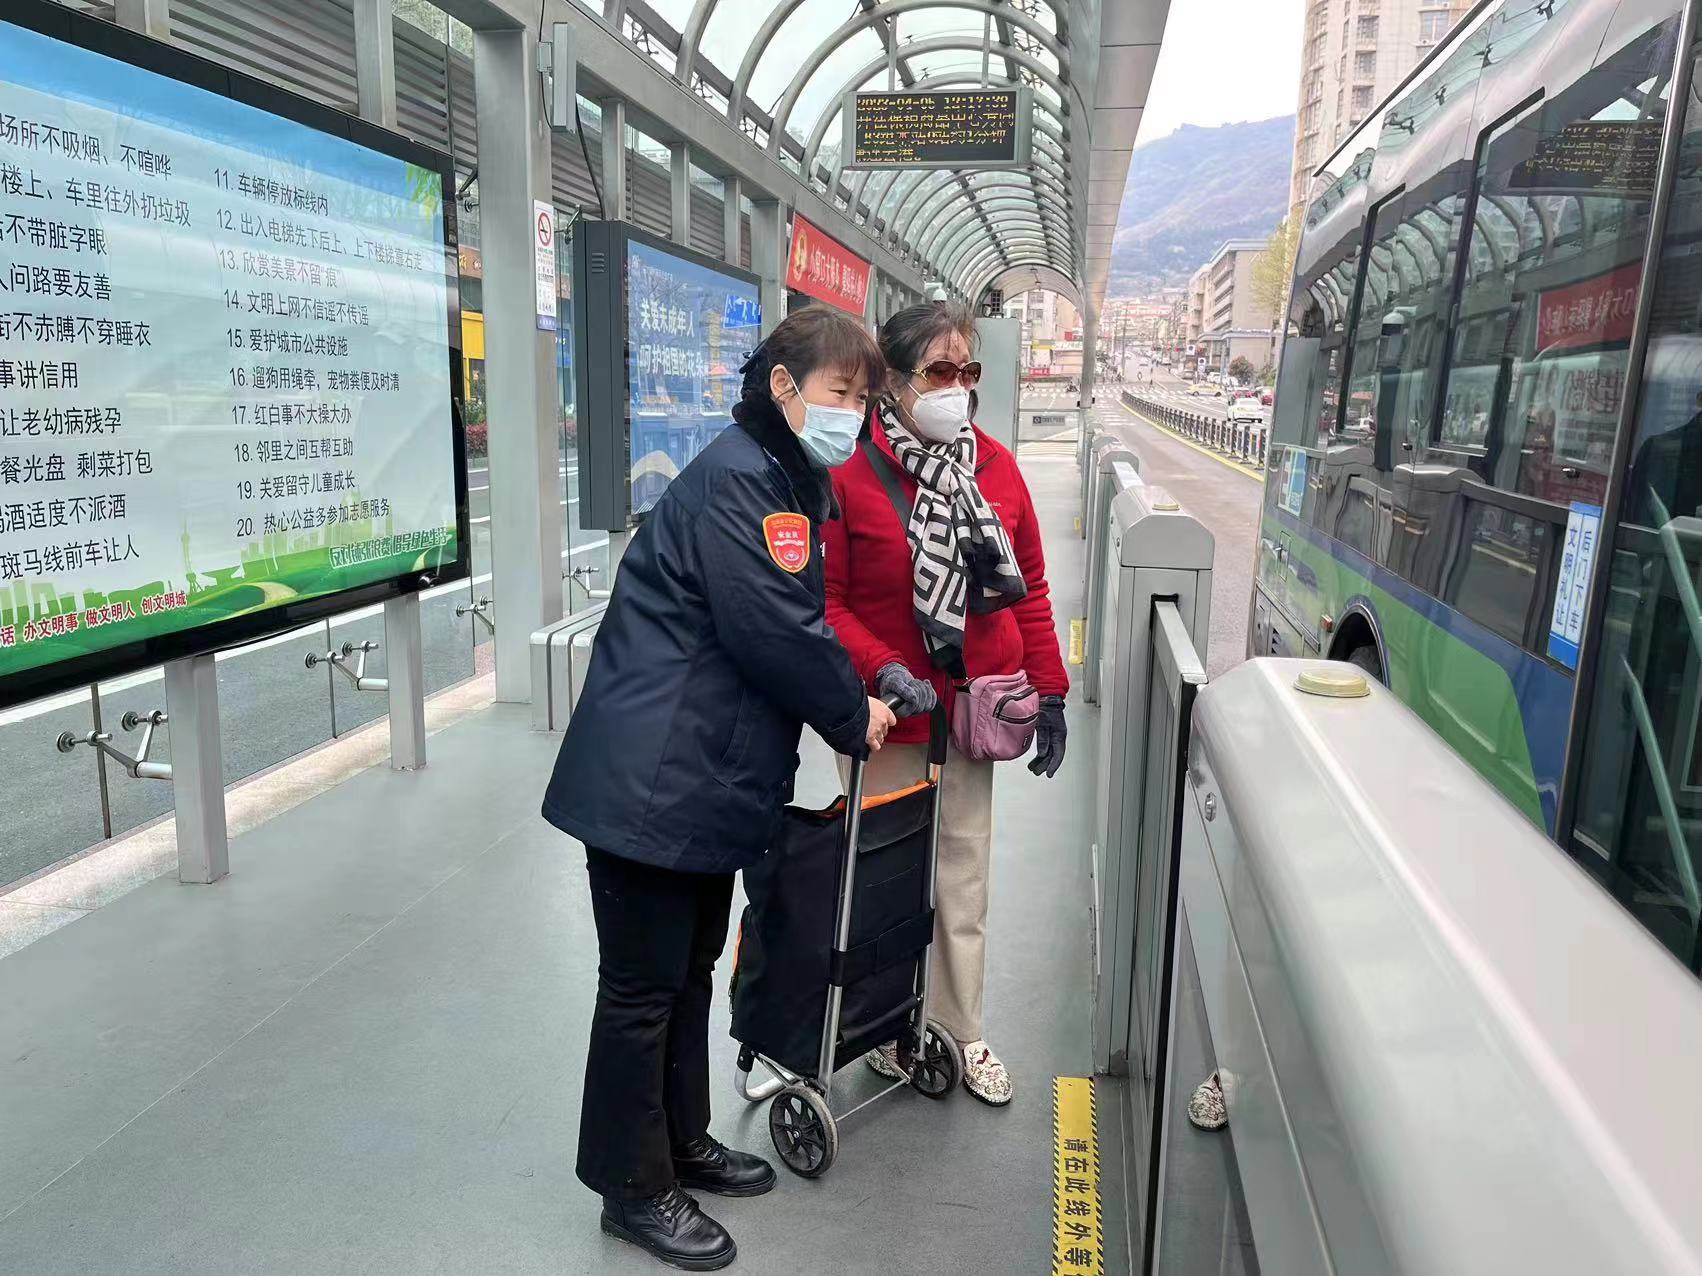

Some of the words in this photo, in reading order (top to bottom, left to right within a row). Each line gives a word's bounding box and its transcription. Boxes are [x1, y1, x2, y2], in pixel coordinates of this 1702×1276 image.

[0, 113, 172, 181] 场所不吸烟、不喧哗
[1, 162, 192, 228] 楼上、车里往外扔垃圾
[641, 297, 695, 338] 关爱未成年人
[0, 359, 78, 390] 事讲信用
[640, 343, 705, 378] 呵护祖国的花朵
[0, 406, 122, 437] 让老幼病残孕
[0, 453, 66, 485] 餐光盘
[77, 449, 153, 479] 剩菜打包
[0, 493, 126, 534] 酒适度不派酒
[0, 534, 140, 580] 斑马线前车让人
[24, 612, 80, 642] 办文明事
[86, 600, 136, 629] 做文明人
[141, 590, 188, 616] 创文明城
[1064, 1138, 1093, 1276] 请在此线外等
